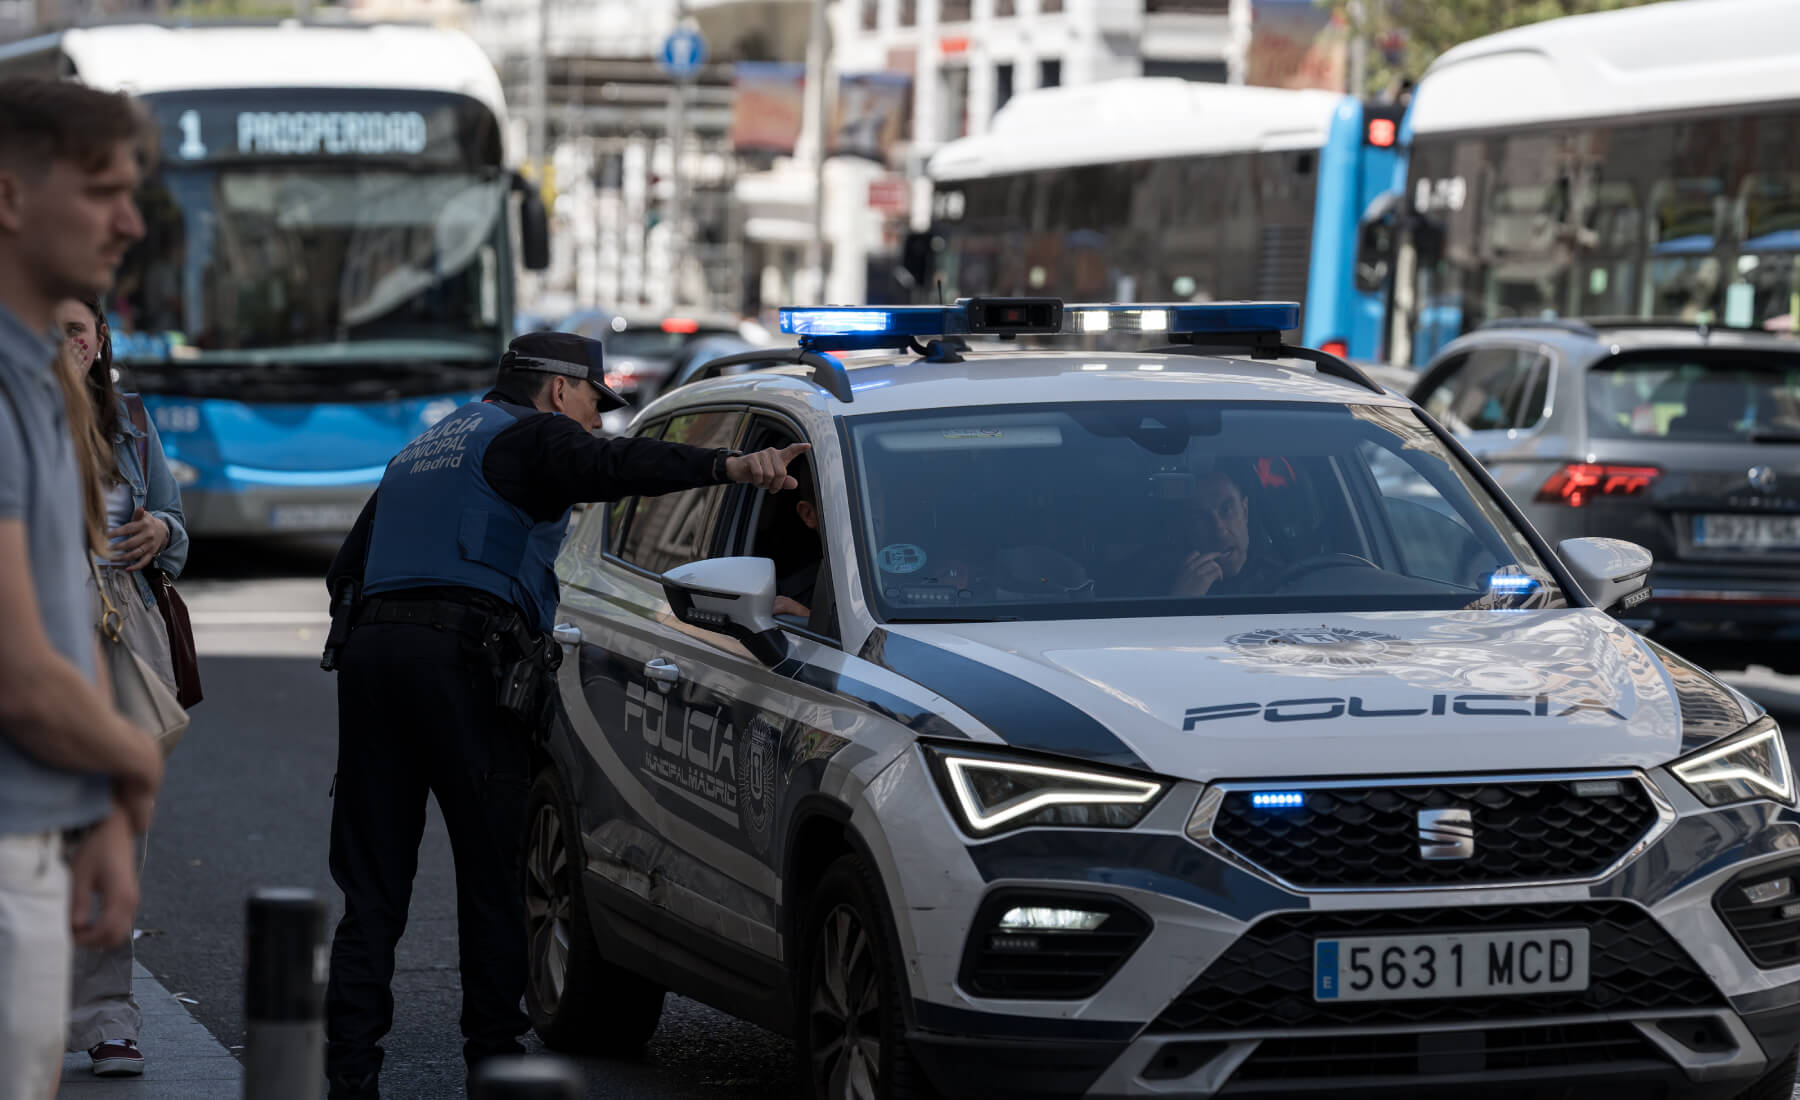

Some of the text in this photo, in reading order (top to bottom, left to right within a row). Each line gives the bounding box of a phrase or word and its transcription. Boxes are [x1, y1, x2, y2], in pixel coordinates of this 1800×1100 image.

[179, 109, 207, 160] 1
[410, 454, 464, 474] Madrid
[625, 681, 735, 781] POLICÍA
[1323, 939, 1573, 990] E 5631 MCD
